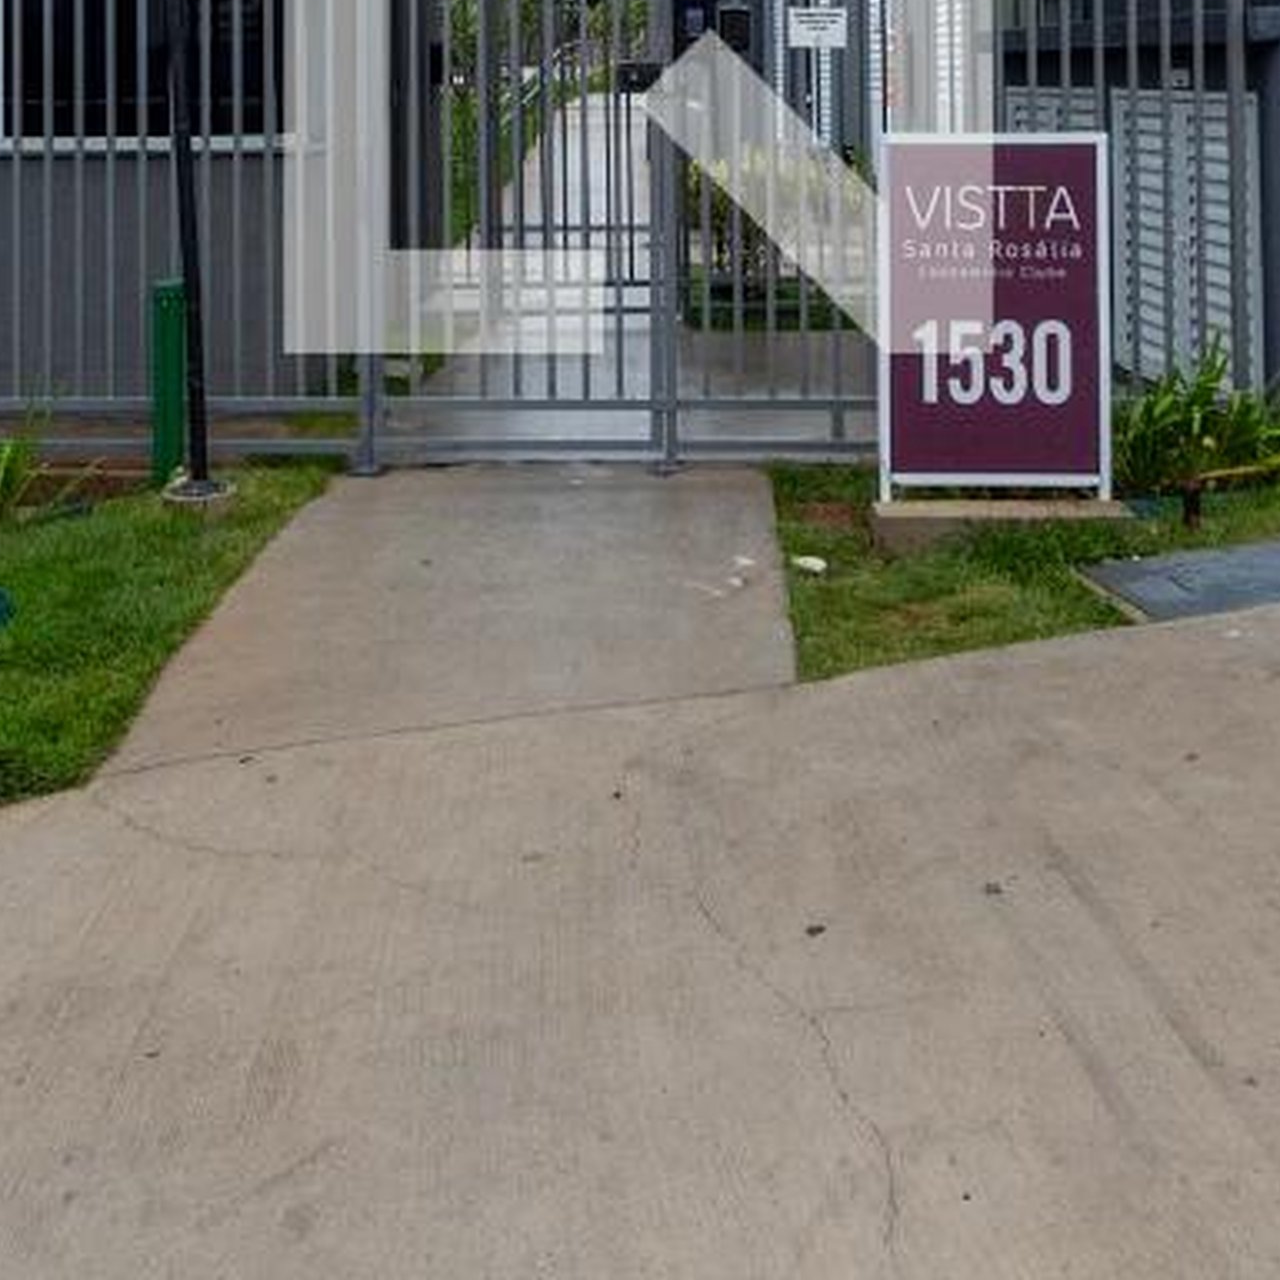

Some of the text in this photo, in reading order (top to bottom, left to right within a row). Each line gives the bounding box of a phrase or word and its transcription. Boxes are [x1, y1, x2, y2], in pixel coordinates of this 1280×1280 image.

[905, 185, 1081, 231] VISTTA
[901, 238, 1083, 260] Santa Rosália
[912, 319, 1072, 405] 1530
